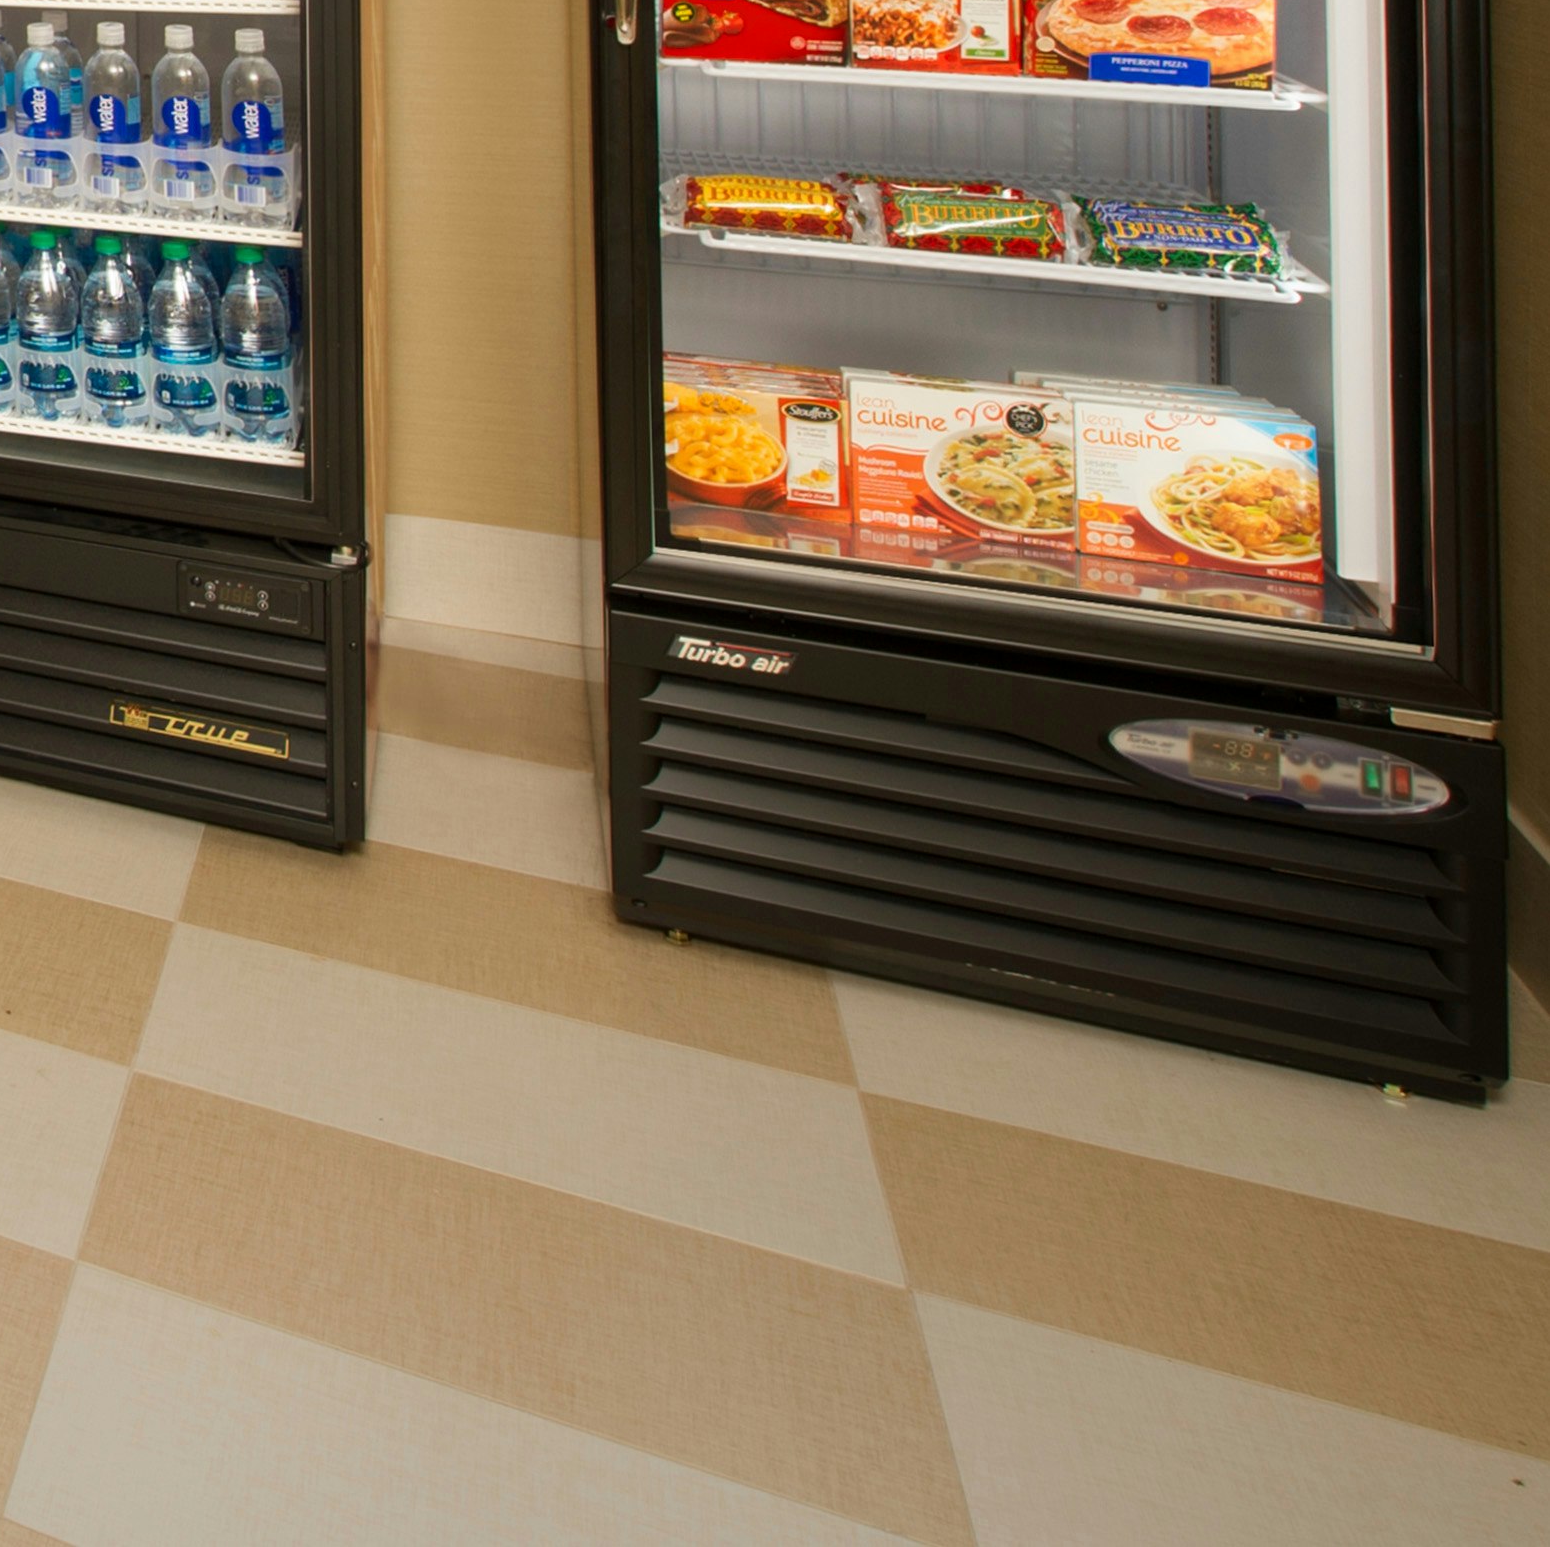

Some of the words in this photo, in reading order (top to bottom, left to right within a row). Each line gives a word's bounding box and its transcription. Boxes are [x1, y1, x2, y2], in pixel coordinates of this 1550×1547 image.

[1111, 56, 1162, 68] PEPPERONI
[1163, 58, 1189, 70] PIZZA
[910, 201, 1042, 230] BURRITO
[1112, 218, 1255, 246] BURRITO
[788, 405, 837, 421] Stouffer's
[856, 393, 896, 410] lean
[856, 406, 948, 432] cuisine
[1081, 409, 1124, 427] lean
[1081, 427, 1183, 452] cuisine
[677, 635, 747, 669] Turbo
[750, 654, 790, 675] air
